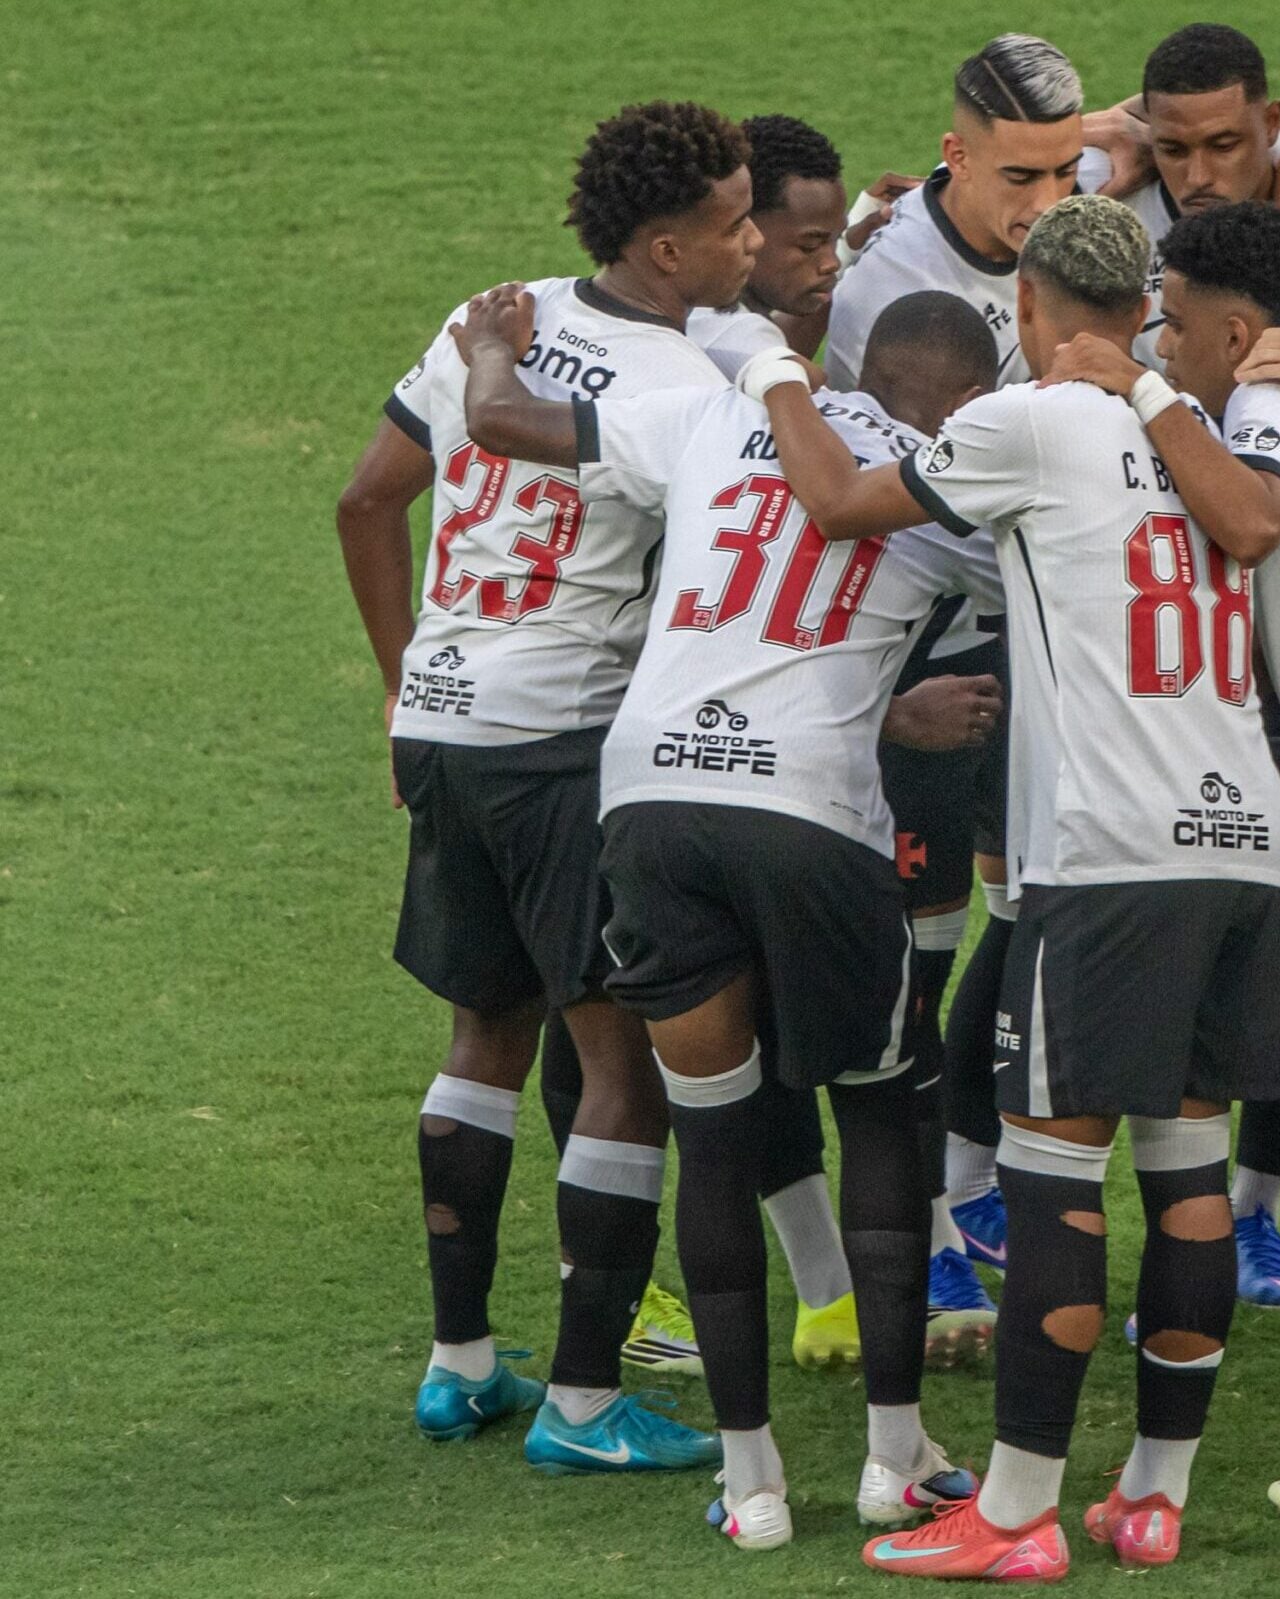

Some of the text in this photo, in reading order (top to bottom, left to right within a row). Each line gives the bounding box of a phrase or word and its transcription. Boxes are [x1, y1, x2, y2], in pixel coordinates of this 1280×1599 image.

[556, 327, 608, 357] banco
[1122, 451, 1147, 490] C.
[769, 488, 785, 520] SCORE
[426, 440, 589, 625] 23
[665, 472, 892, 652] 30
[1122, 511, 1254, 707] 88
[422, 673, 456, 688] MOTO
[401, 683, 475, 716] CHEFE
[691, 733, 744, 747] MOTO
[653, 743, 777, 776] CHEFE
[1205, 809, 1245, 822] MOTO
[1173, 821, 1269, 851] CHEFE
